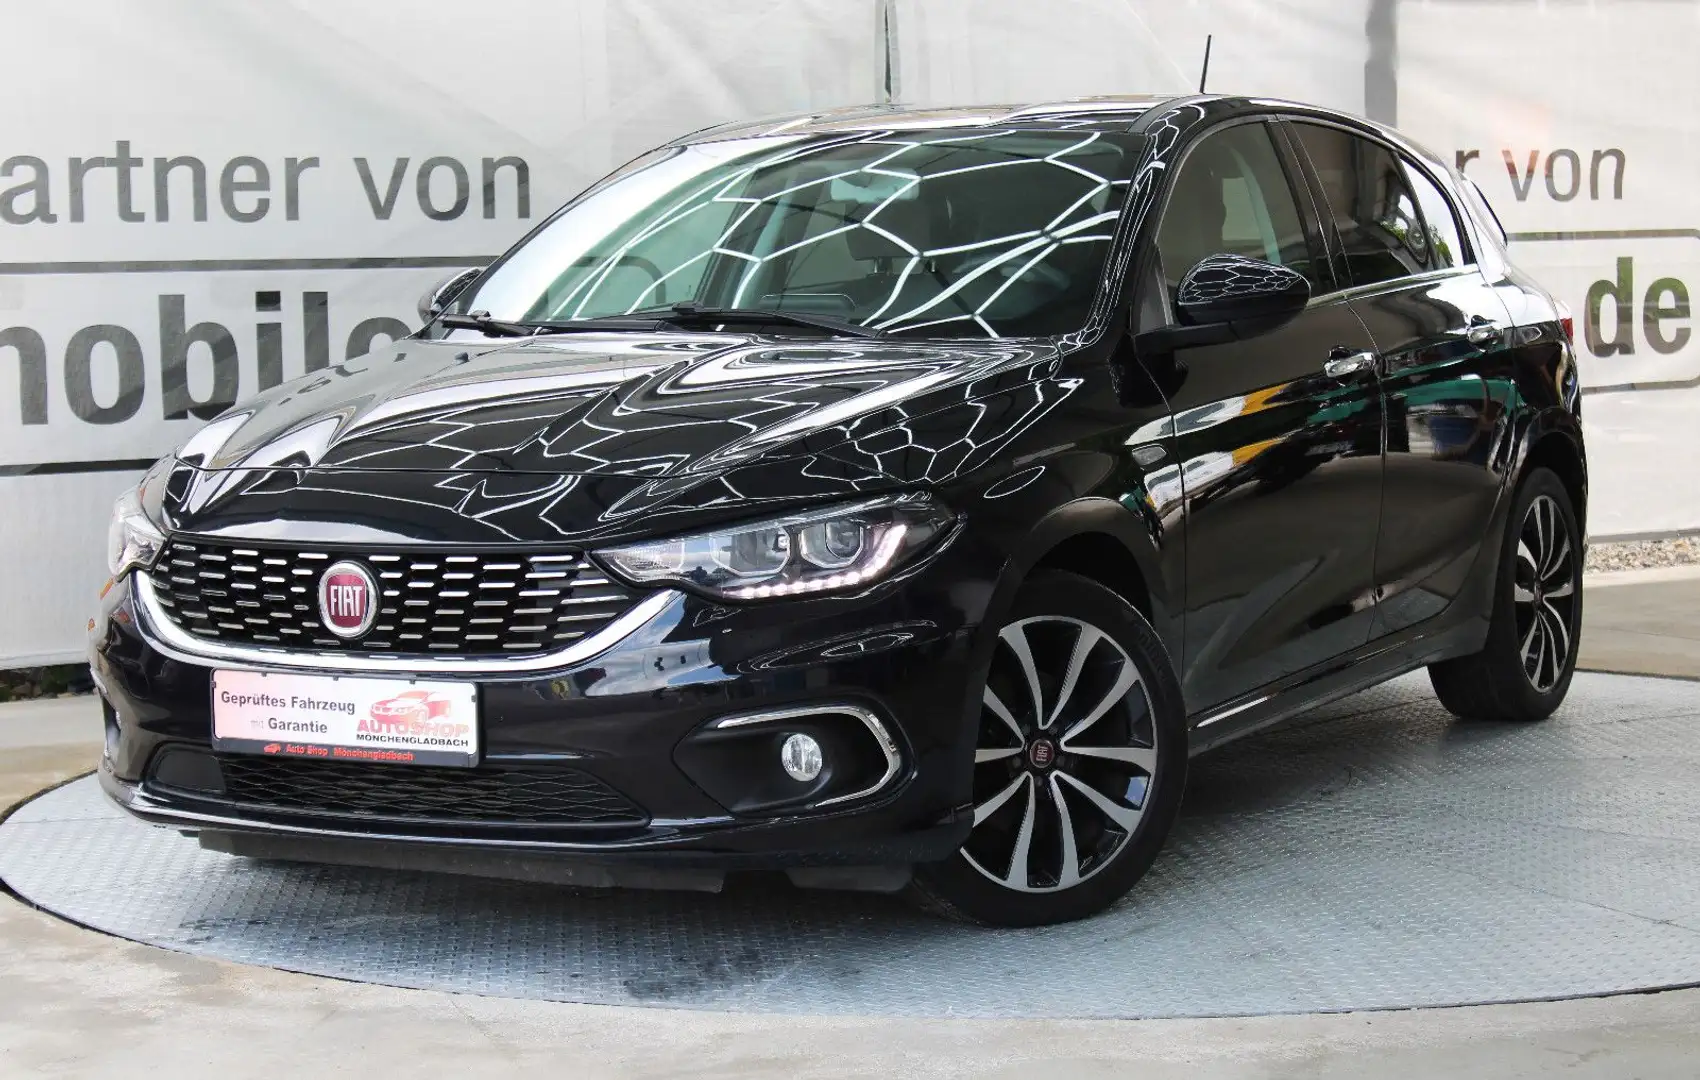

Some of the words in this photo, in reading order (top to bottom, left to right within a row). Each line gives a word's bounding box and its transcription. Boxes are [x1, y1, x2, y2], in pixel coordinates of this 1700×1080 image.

[1501, 148, 1626, 202] von
[353, 156, 530, 222] von
[330, 585, 363, 616] FIAT
[221, 691, 287, 708] Geprüftes
[291, 696, 355, 715] Fahrzeug
[268, 717, 328, 734] Garantie
[1036, 744, 1048, 762] FIAT
